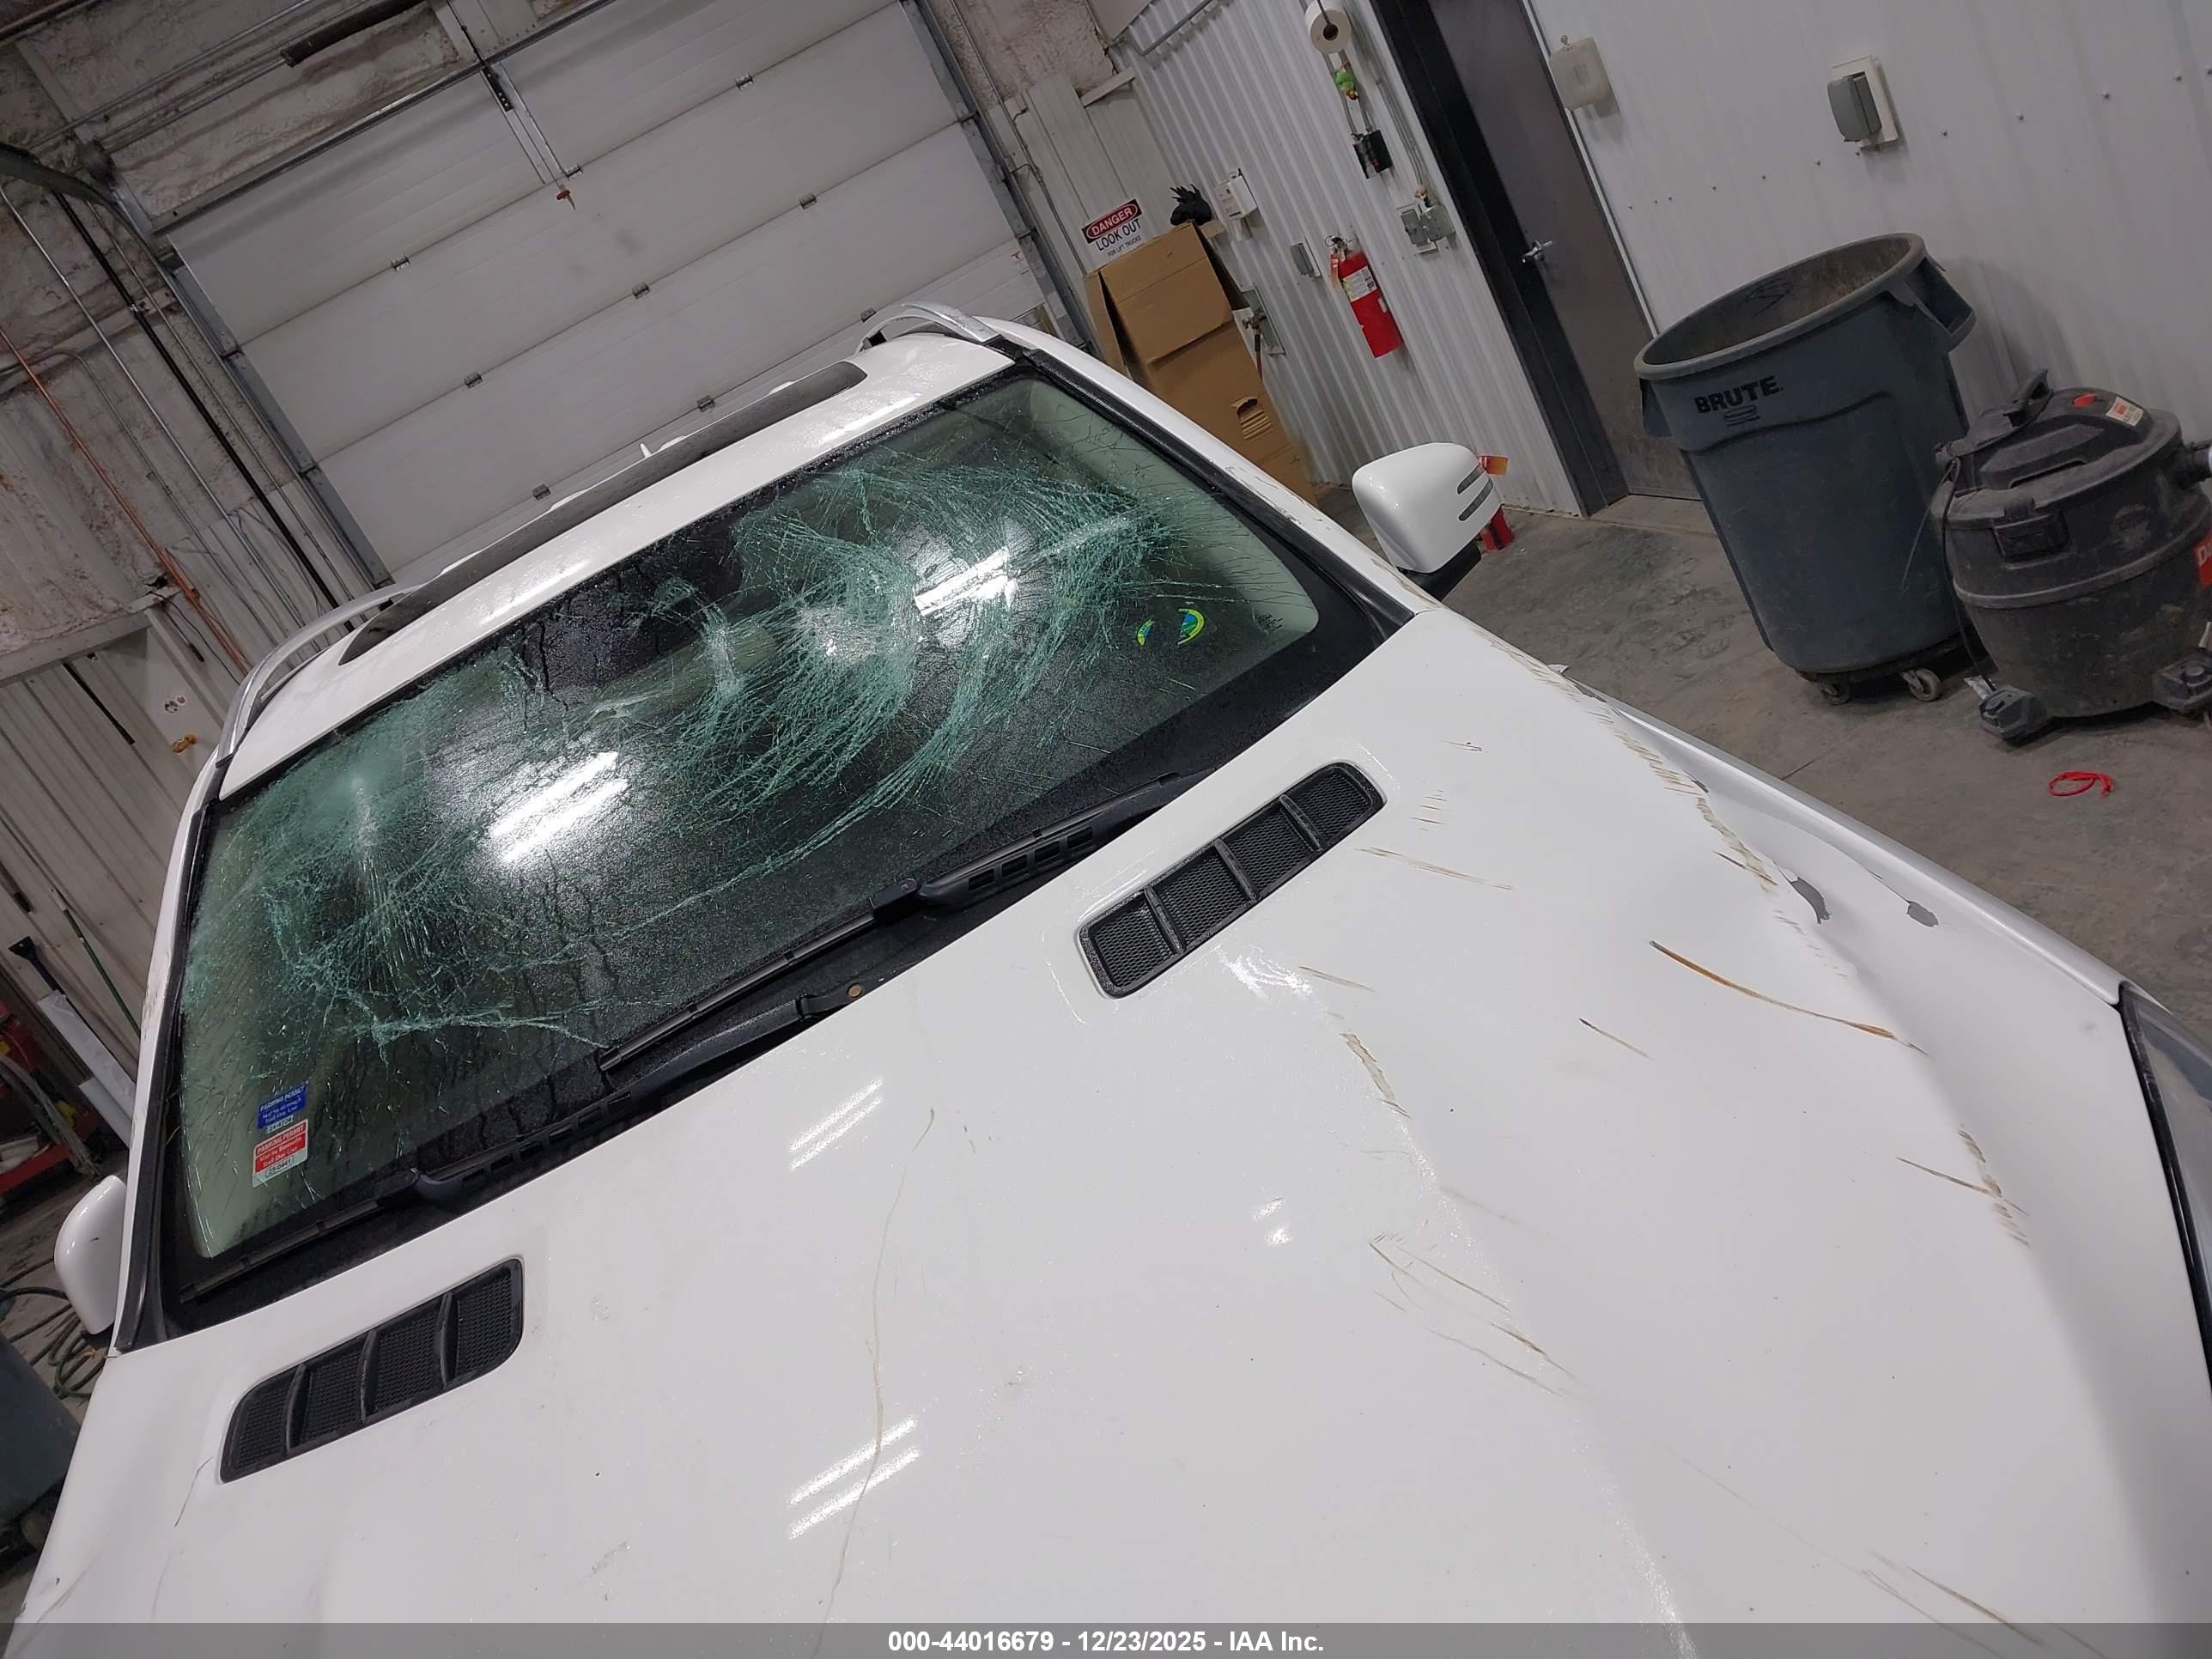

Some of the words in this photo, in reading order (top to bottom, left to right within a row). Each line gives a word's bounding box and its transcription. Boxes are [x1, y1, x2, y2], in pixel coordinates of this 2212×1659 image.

[1091, 207, 1133, 236] DANGER
[1096, 229, 1122, 251] LOOK
[1122, 219, 1141, 236] OUT
[1694, 375, 1780, 413] BRUTE
[257, 1136, 283, 1154] PARKING
[283, 1125, 304, 1140] PERMIT
